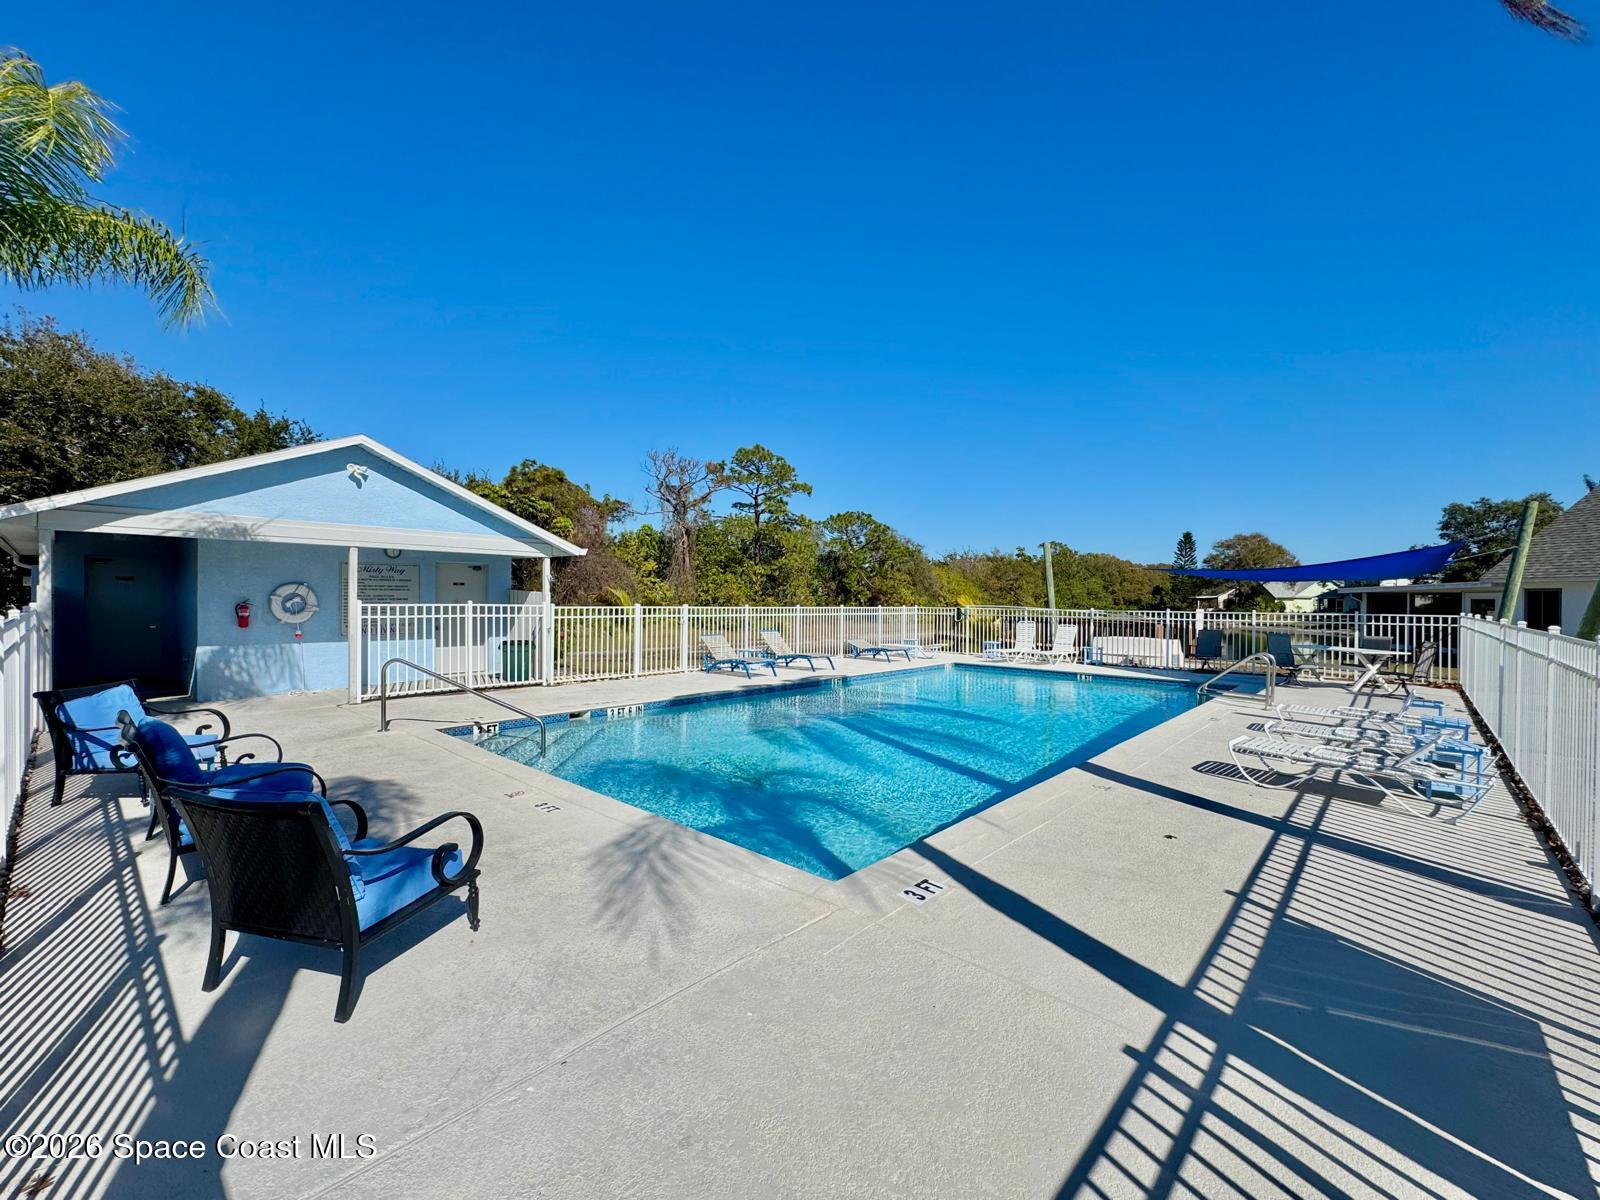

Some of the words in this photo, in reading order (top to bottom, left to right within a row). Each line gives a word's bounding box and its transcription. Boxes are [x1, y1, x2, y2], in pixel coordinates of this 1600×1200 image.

[385, 566, 405, 575] Way
[635, 705, 643, 715] IN
[486, 724, 498, 733] FT
[913, 878, 944, 895] FT
[903, 889, 927, 901] 3
